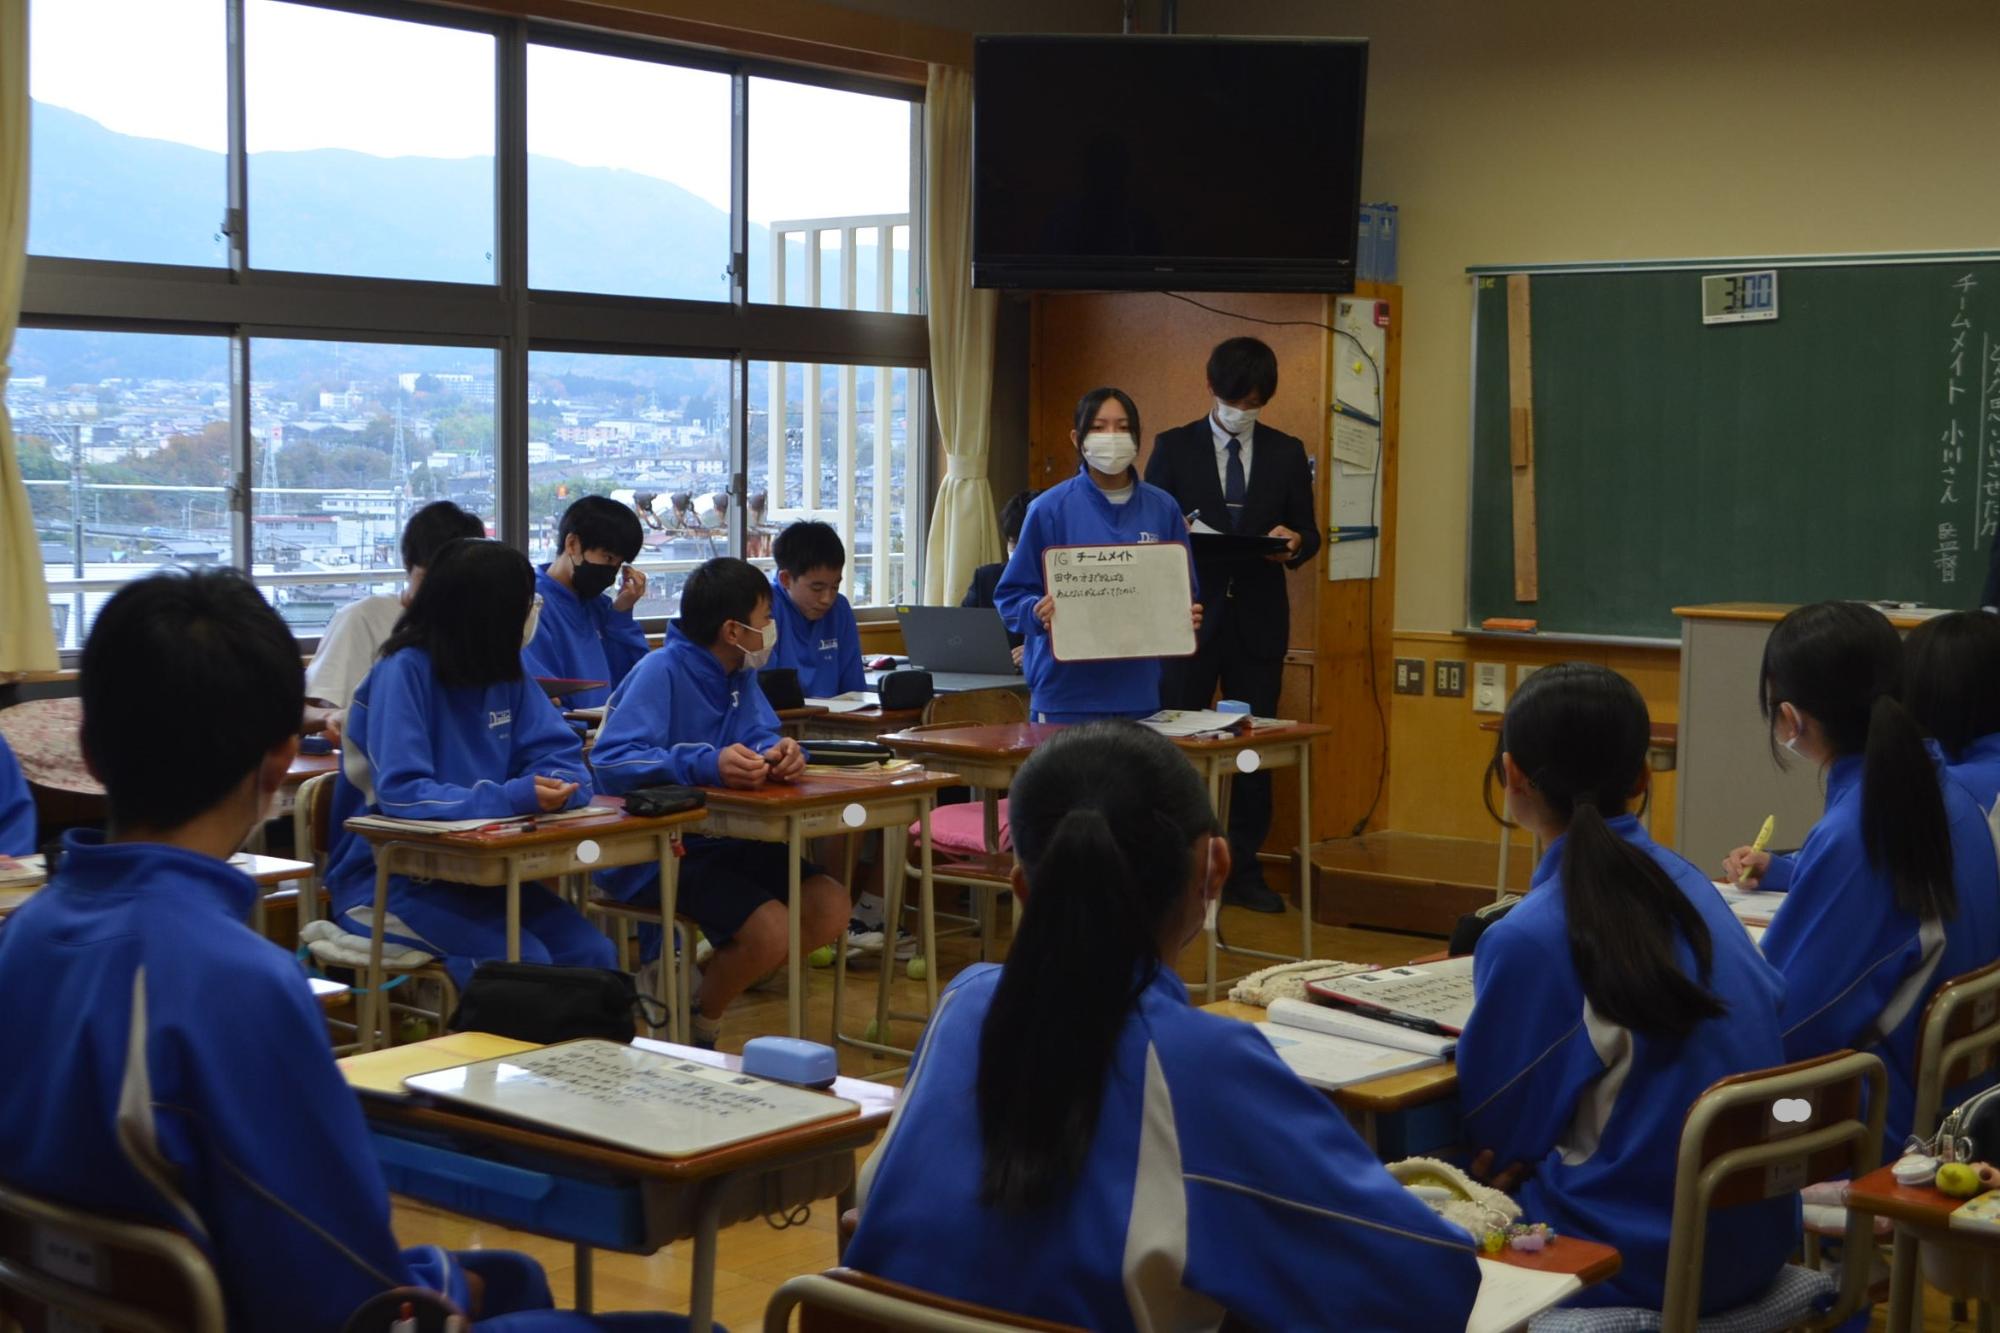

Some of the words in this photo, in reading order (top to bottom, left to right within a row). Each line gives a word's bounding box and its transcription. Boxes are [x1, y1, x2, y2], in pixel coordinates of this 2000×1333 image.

[1949, 273, 1977, 405] チームメイト
[1077, 551, 1133, 562] チームメイト
